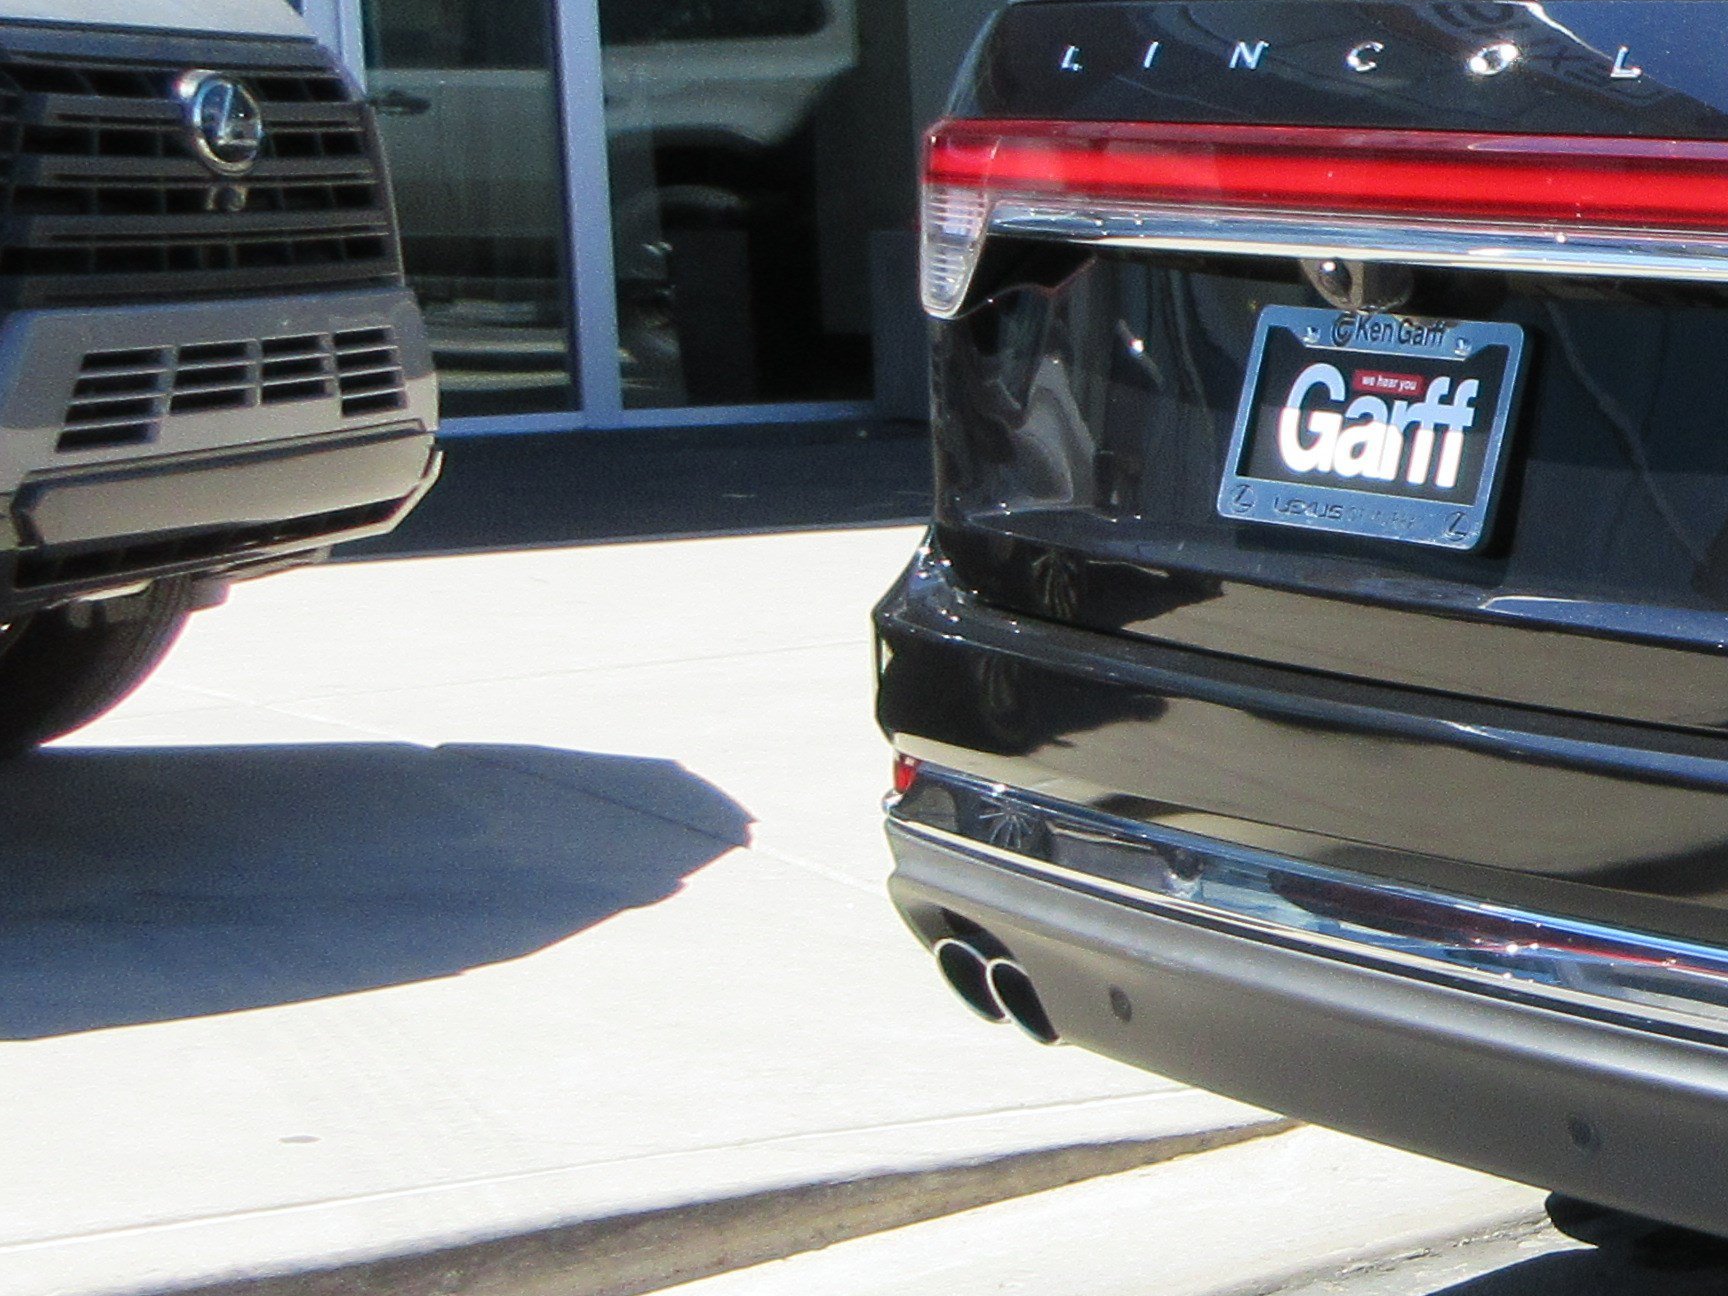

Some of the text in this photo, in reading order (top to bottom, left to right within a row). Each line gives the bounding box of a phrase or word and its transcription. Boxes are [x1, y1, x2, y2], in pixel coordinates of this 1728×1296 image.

[1354, 315, 1450, 347] Ken Garff
[1377, 373, 1399, 388] hear
[1399, 378, 1418, 392] you
[1278, 363, 1480, 488] Garff
[1273, 496, 1344, 520] LEXUS
